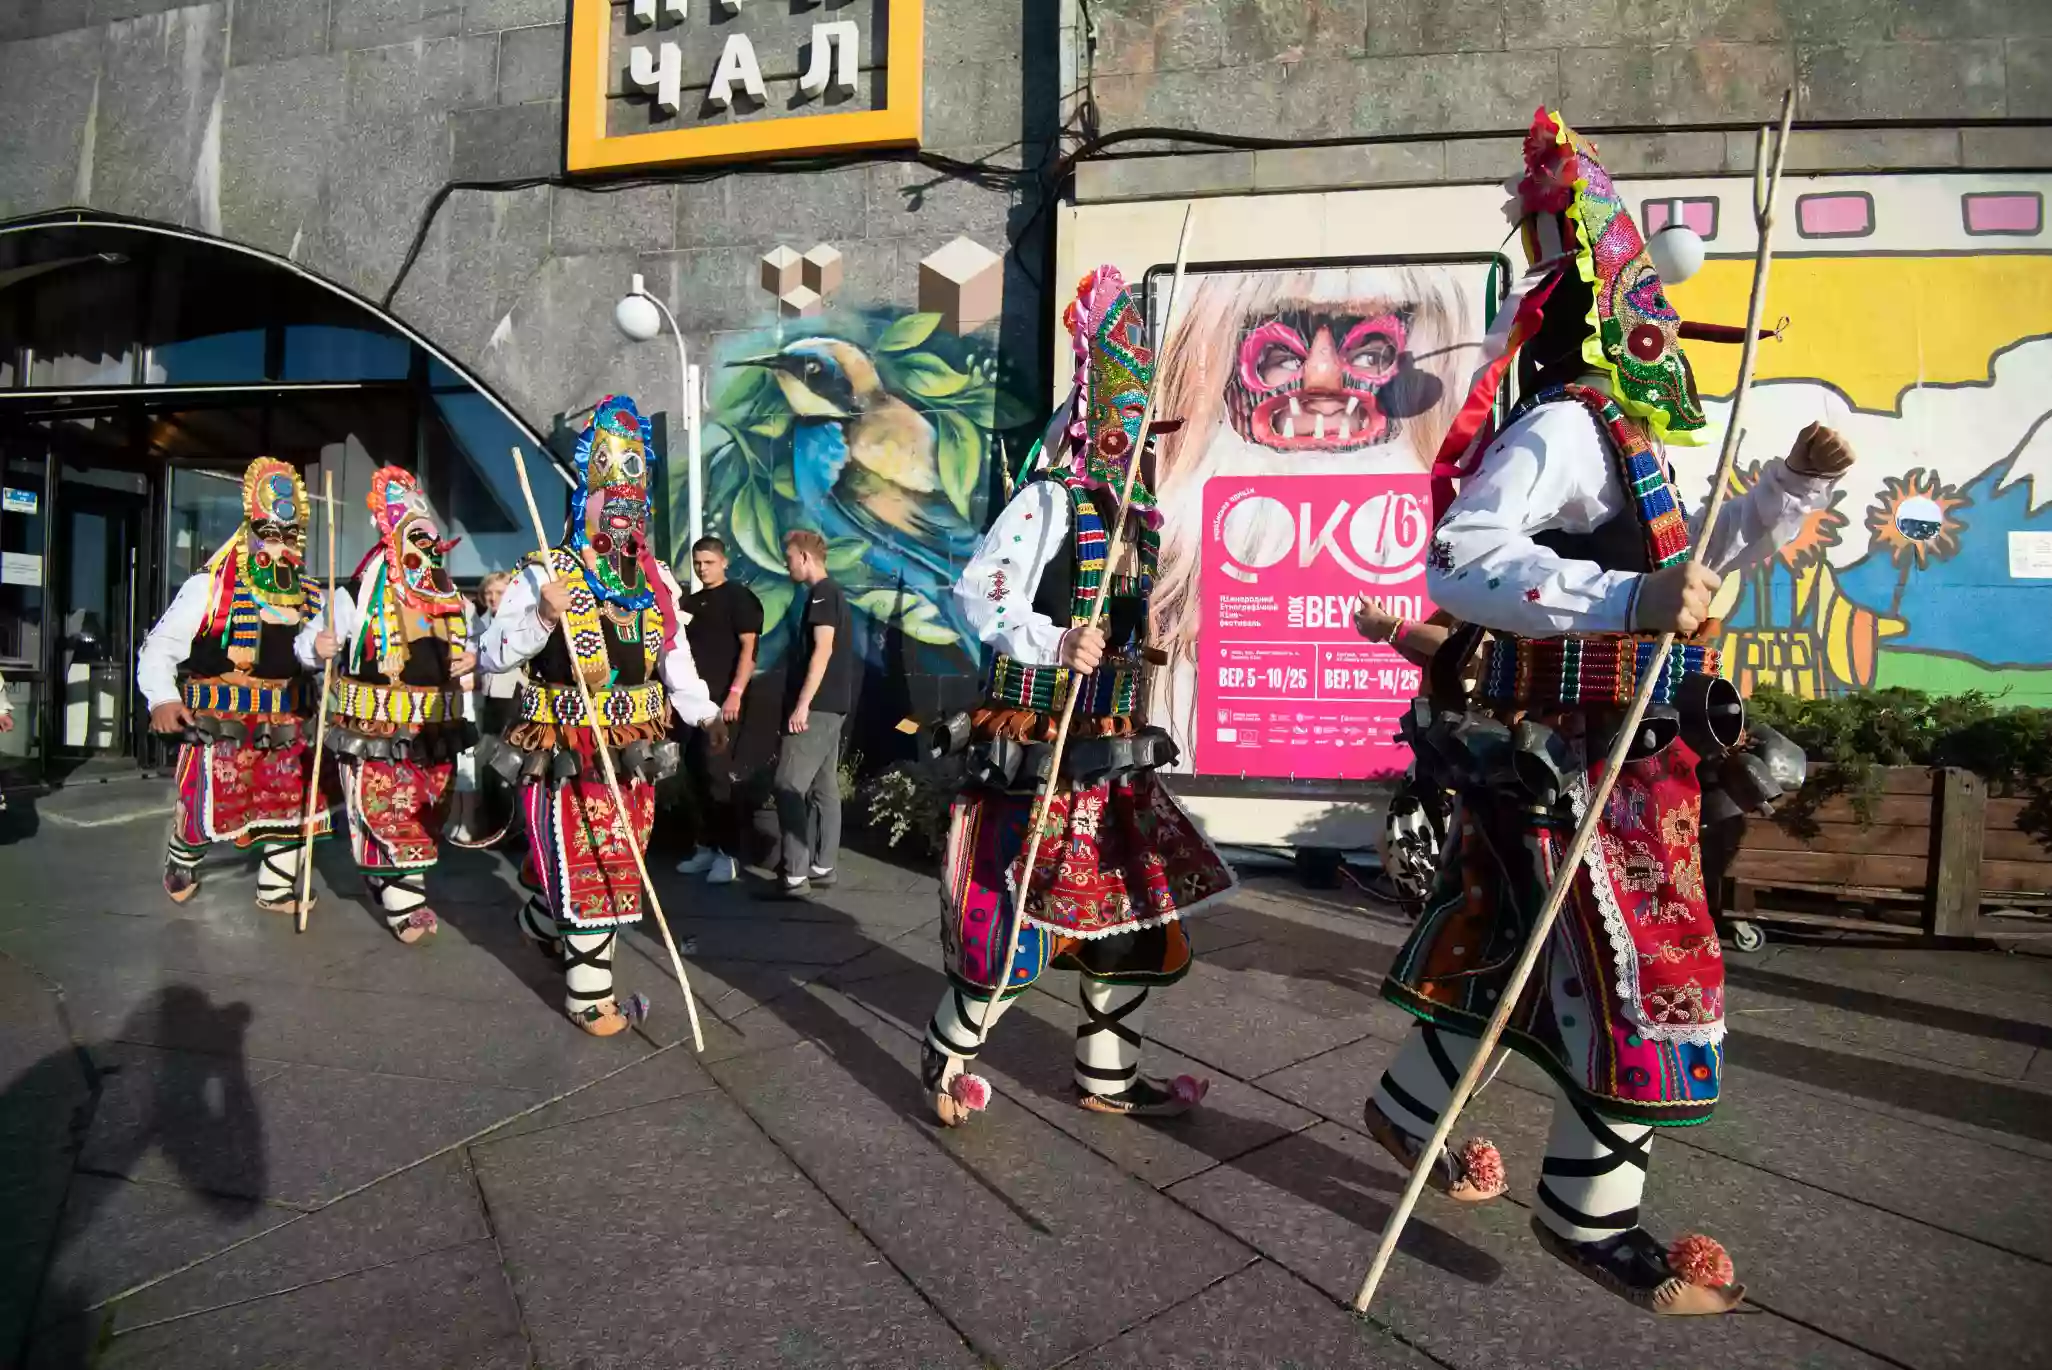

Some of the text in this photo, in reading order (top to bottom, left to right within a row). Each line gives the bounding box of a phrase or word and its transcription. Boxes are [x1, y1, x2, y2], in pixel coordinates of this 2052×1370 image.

[630, 20, 859, 112] ЧАЛ
[1287, 595, 1422, 629] LOOK BEYD!
